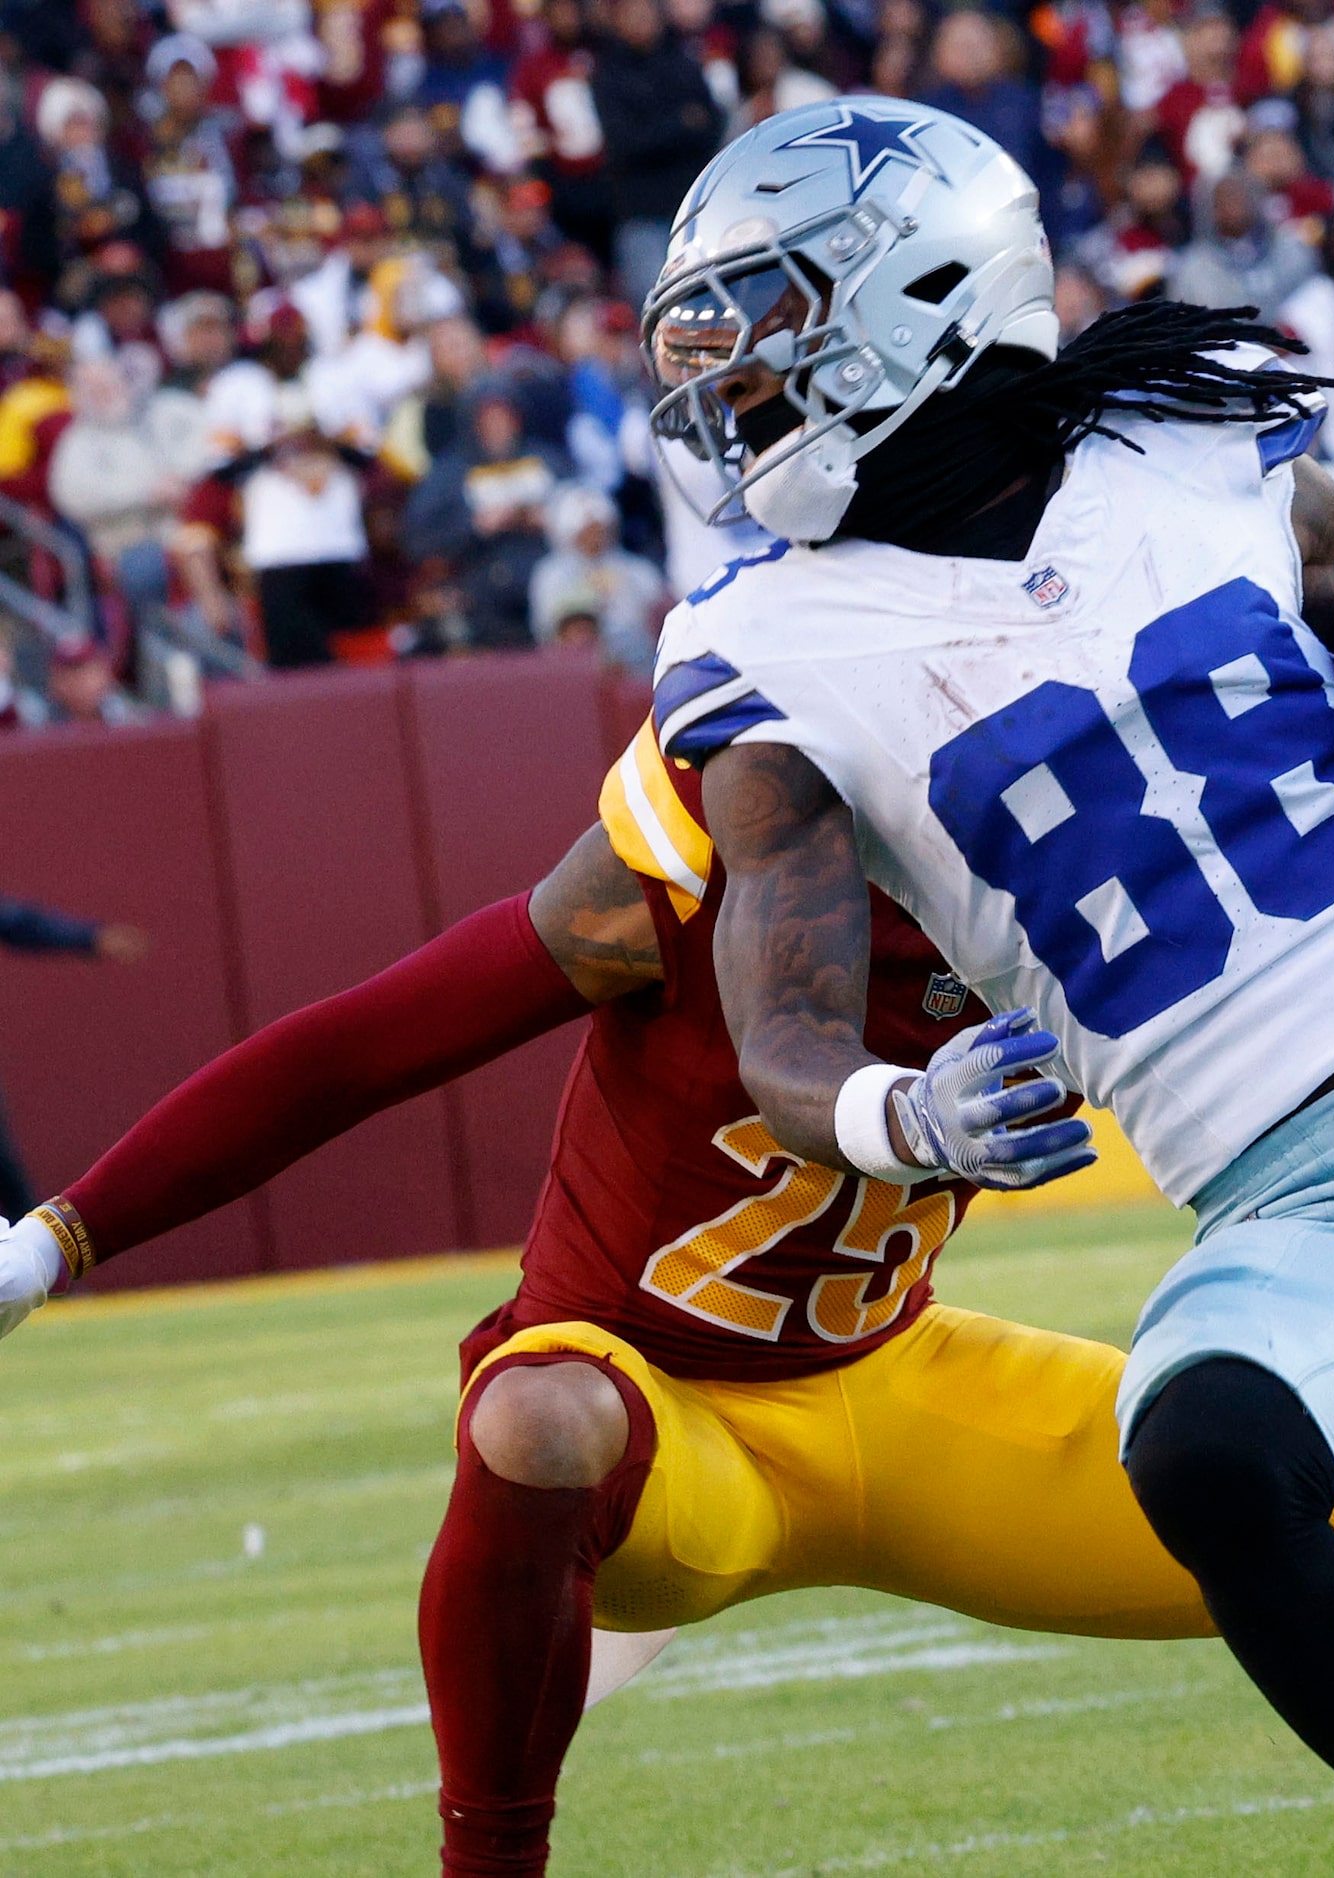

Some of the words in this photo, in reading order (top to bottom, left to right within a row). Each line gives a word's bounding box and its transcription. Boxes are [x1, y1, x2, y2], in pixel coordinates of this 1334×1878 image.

[1035, 580, 1065, 602] NFL
[929, 993, 959, 1012] NFL
[72, 1221, 87, 1241] DAY
[639, 1114, 956, 1344] 25
